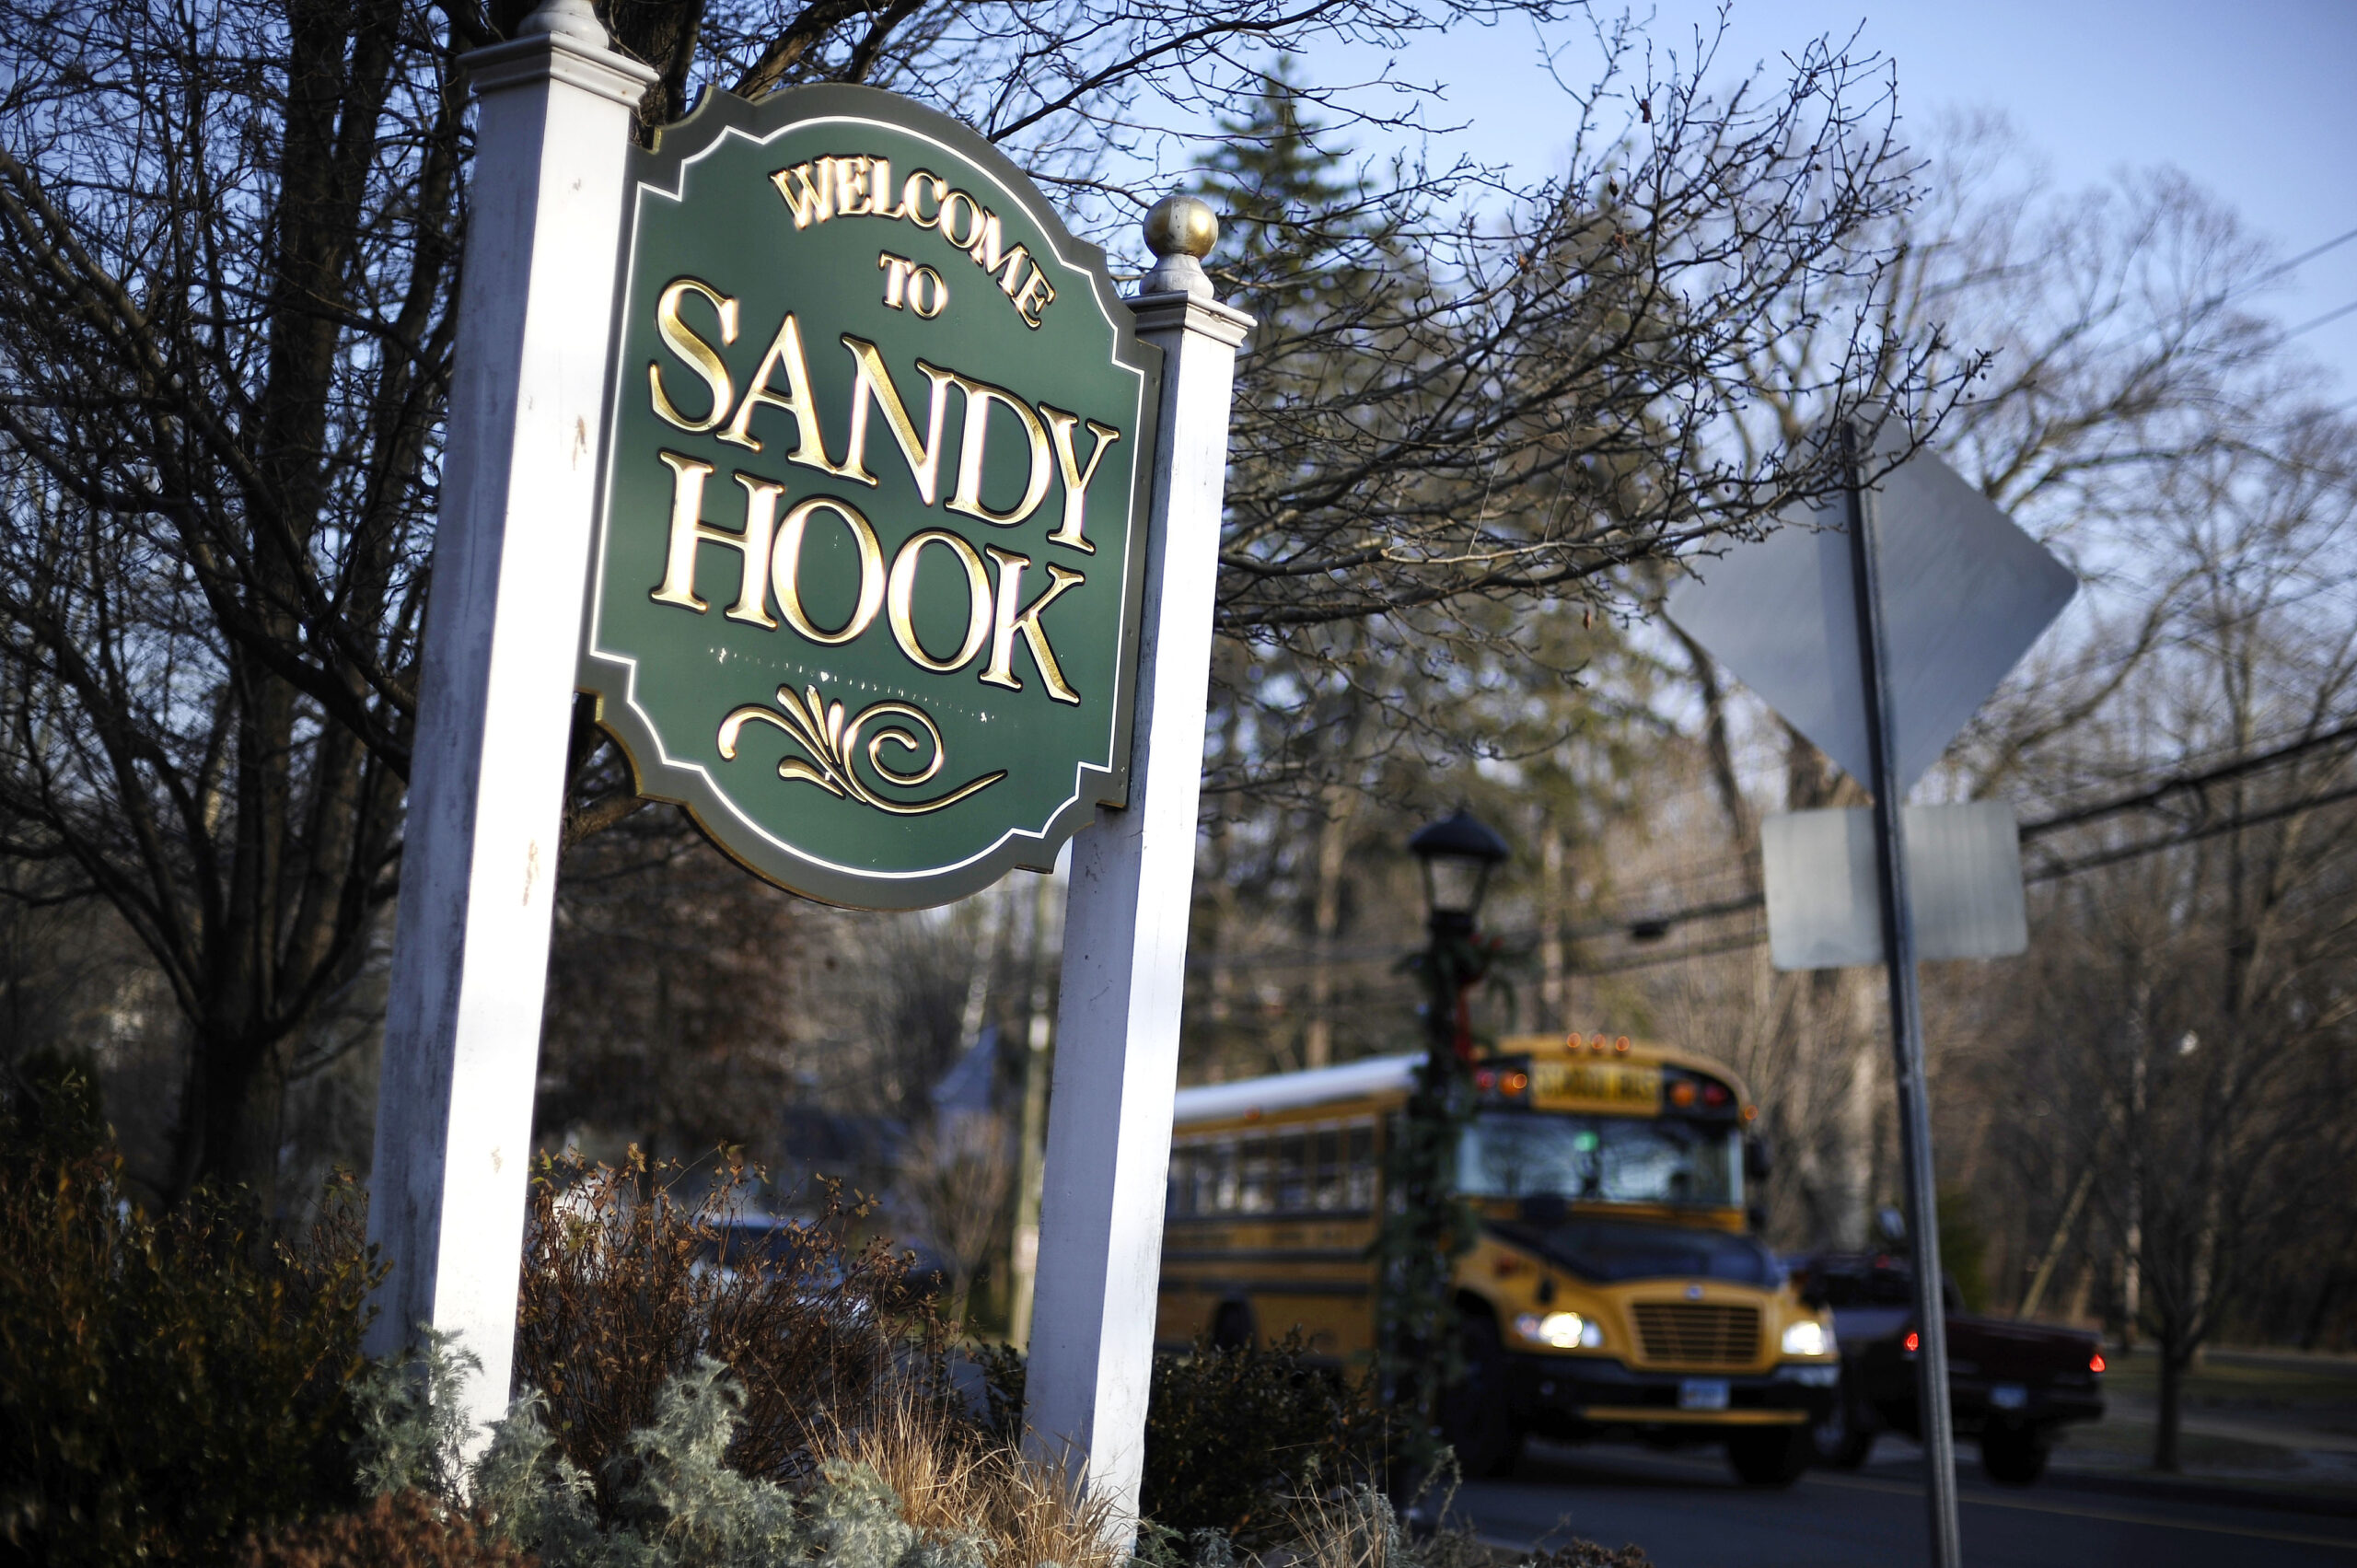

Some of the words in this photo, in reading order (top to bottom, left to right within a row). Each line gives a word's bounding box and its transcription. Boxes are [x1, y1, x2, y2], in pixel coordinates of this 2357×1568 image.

[768, 153, 1056, 329] WELCOME
[877, 250, 947, 319] TO
[648, 275, 1120, 554] SANDY
[649, 450, 1085, 705] HOOK
